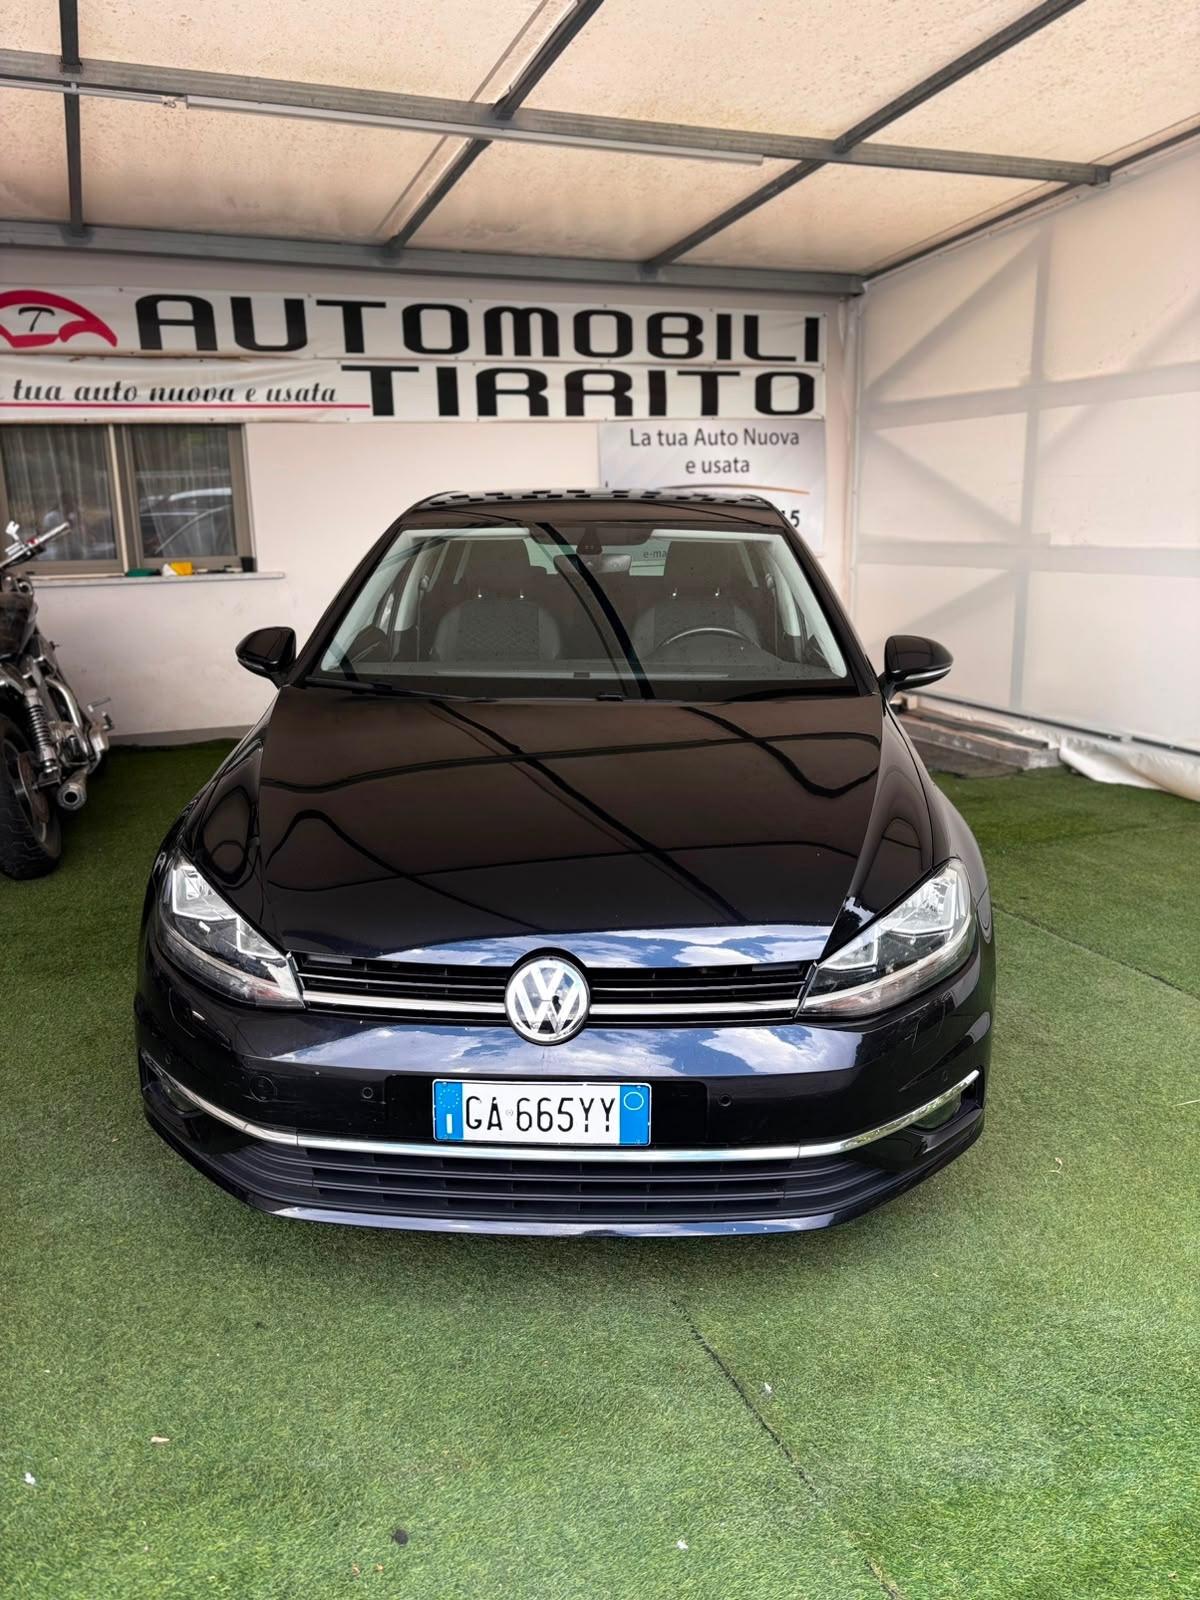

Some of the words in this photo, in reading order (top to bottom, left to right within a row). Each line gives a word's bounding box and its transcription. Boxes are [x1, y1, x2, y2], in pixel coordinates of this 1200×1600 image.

[134, 293, 820, 363] AUTOMOBILI
[13, 379, 63, 401] tua
[74, 380, 138, 402] auto
[148, 386, 235, 402] nuova
[245, 387, 257, 402] e
[266, 382, 336, 402] usata
[340, 364, 816, 417] TIRRITO
[629, 428, 652, 447] La
[657, 430, 689, 447] tua
[693, 427, 739, 446] Auto
[743, 427, 800, 446] Nuova
[685, 460, 696, 474] e
[701, 458, 750, 474] usata
[465, 1095, 503, 1131] GA
[516, 1097, 616, 1133] 665YY
